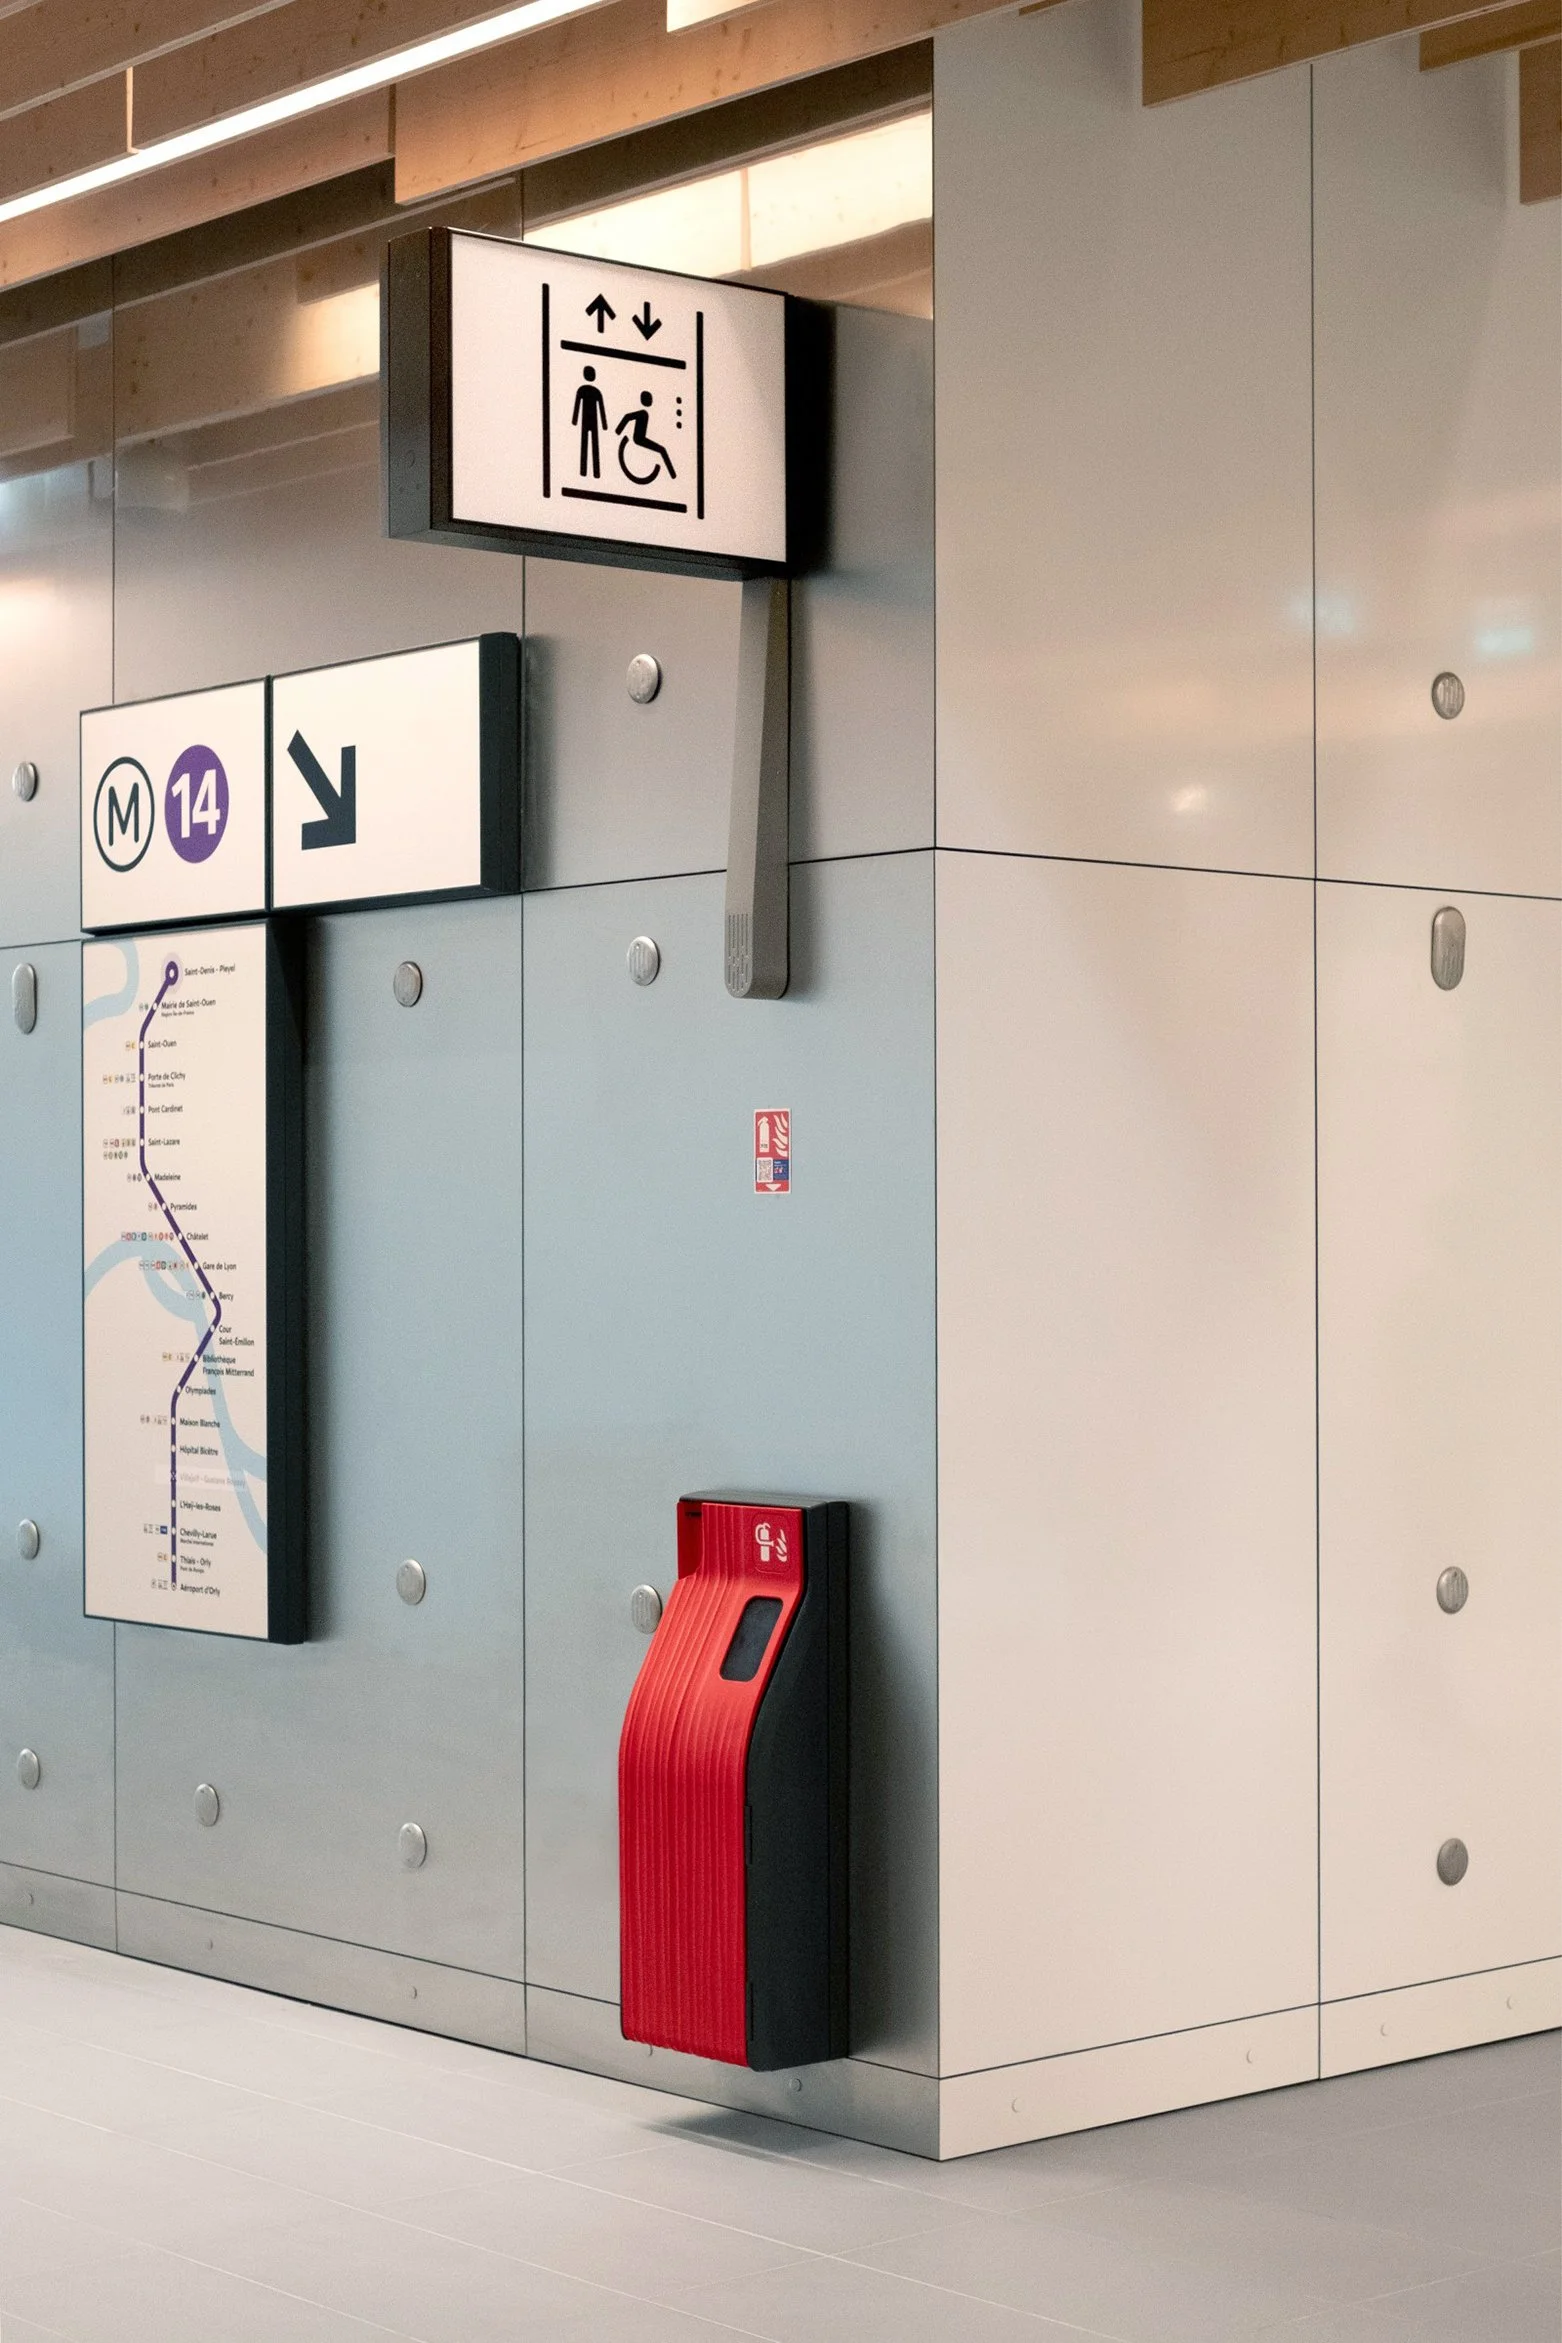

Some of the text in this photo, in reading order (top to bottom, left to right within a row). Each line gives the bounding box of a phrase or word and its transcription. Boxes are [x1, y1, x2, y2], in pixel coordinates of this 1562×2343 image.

[108, 768, 221, 847] M 14
[184, 966, 215, 976] Saint-Denis
[219, 964, 235, 973] Pleyel
[186, 999, 216, 1008] Saint-Ouen
[148, 1040, 177, 1048] Saint-Ouen
[148, 1073, 162, 1081] Porte
[170, 1071, 186, 1081] Clichy
[148, 1104, 183, 1113] Pont Cardinet
[148, 1138, 180, 1146] Saint-Lazare
[154, 1173, 181, 1181] Madeleine
[170, 1203, 197, 1211] Pyramides
[186, 1232, 209, 1240] Châtelet
[202, 1262, 237, 1271] Gare de Lyon
[219, 1292, 234, 1300] Bercy
[219, 1325, 232, 1333] Cour
[219, 1336, 254, 1346] Saint-Émilion
[225, 1368, 254, 1377] Mitterrand
[185, 1386, 216, 1395] Olympiades
[179, 1418, 220, 1428] Maison Blanche
[179, 1445, 199, 1455] Hôpital
[179, 1528, 217, 1540] Chevilly-Larue
[180, 1555, 195, 1566] Thiais
[200, 1558, 211, 1567] Orly
[180, 1583, 204, 1595] Aéroport
[205, 1585, 220, 1597] d'Orly
